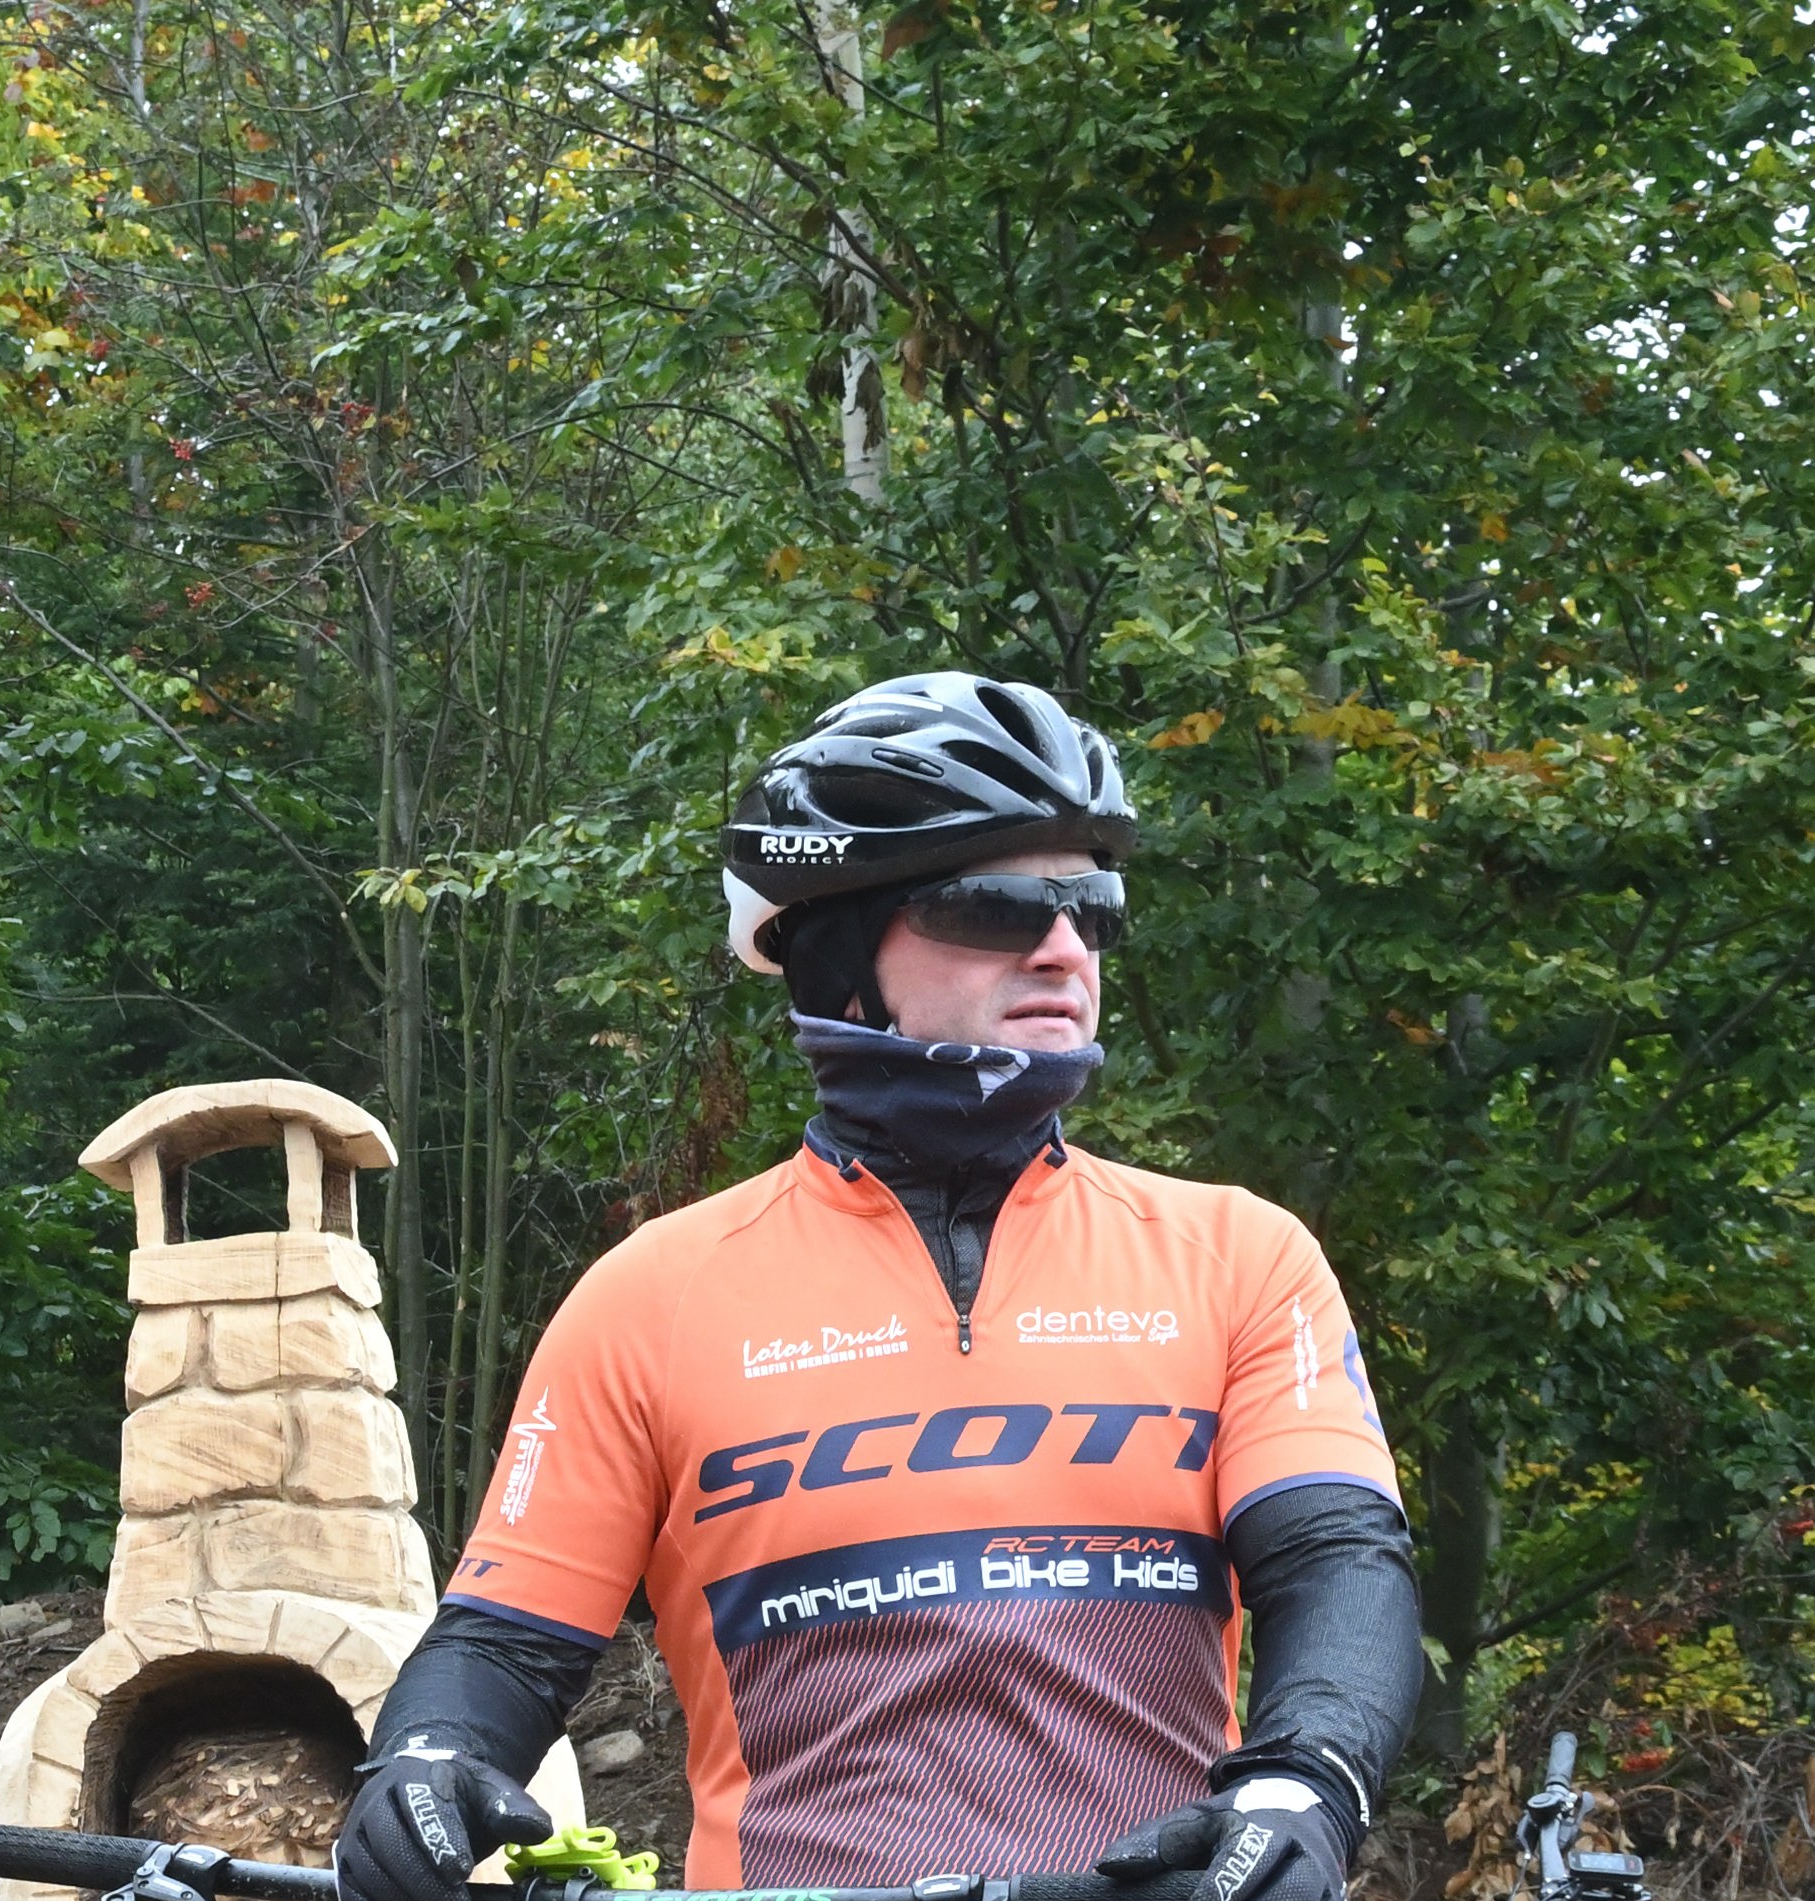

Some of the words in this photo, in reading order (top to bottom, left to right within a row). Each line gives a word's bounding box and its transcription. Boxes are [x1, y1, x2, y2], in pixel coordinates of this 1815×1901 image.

[760, 835, 854, 855] RUDY
[766, 856, 844, 864] PROJECT
[1016, 1305, 1178, 1333] dentevo
[742, 1339, 814, 1368] Lotos
[820, 1314, 907, 1353] Druck
[499, 1438, 532, 1516] SCHELLE
[1062, 1535, 1177, 1555] TEAM
[760, 1560, 958, 1628] miriquidi
[979, 1554, 1090, 1590] bike
[1113, 1553, 1200, 1592] kids
[404, 1782, 458, 1866] ALEX
